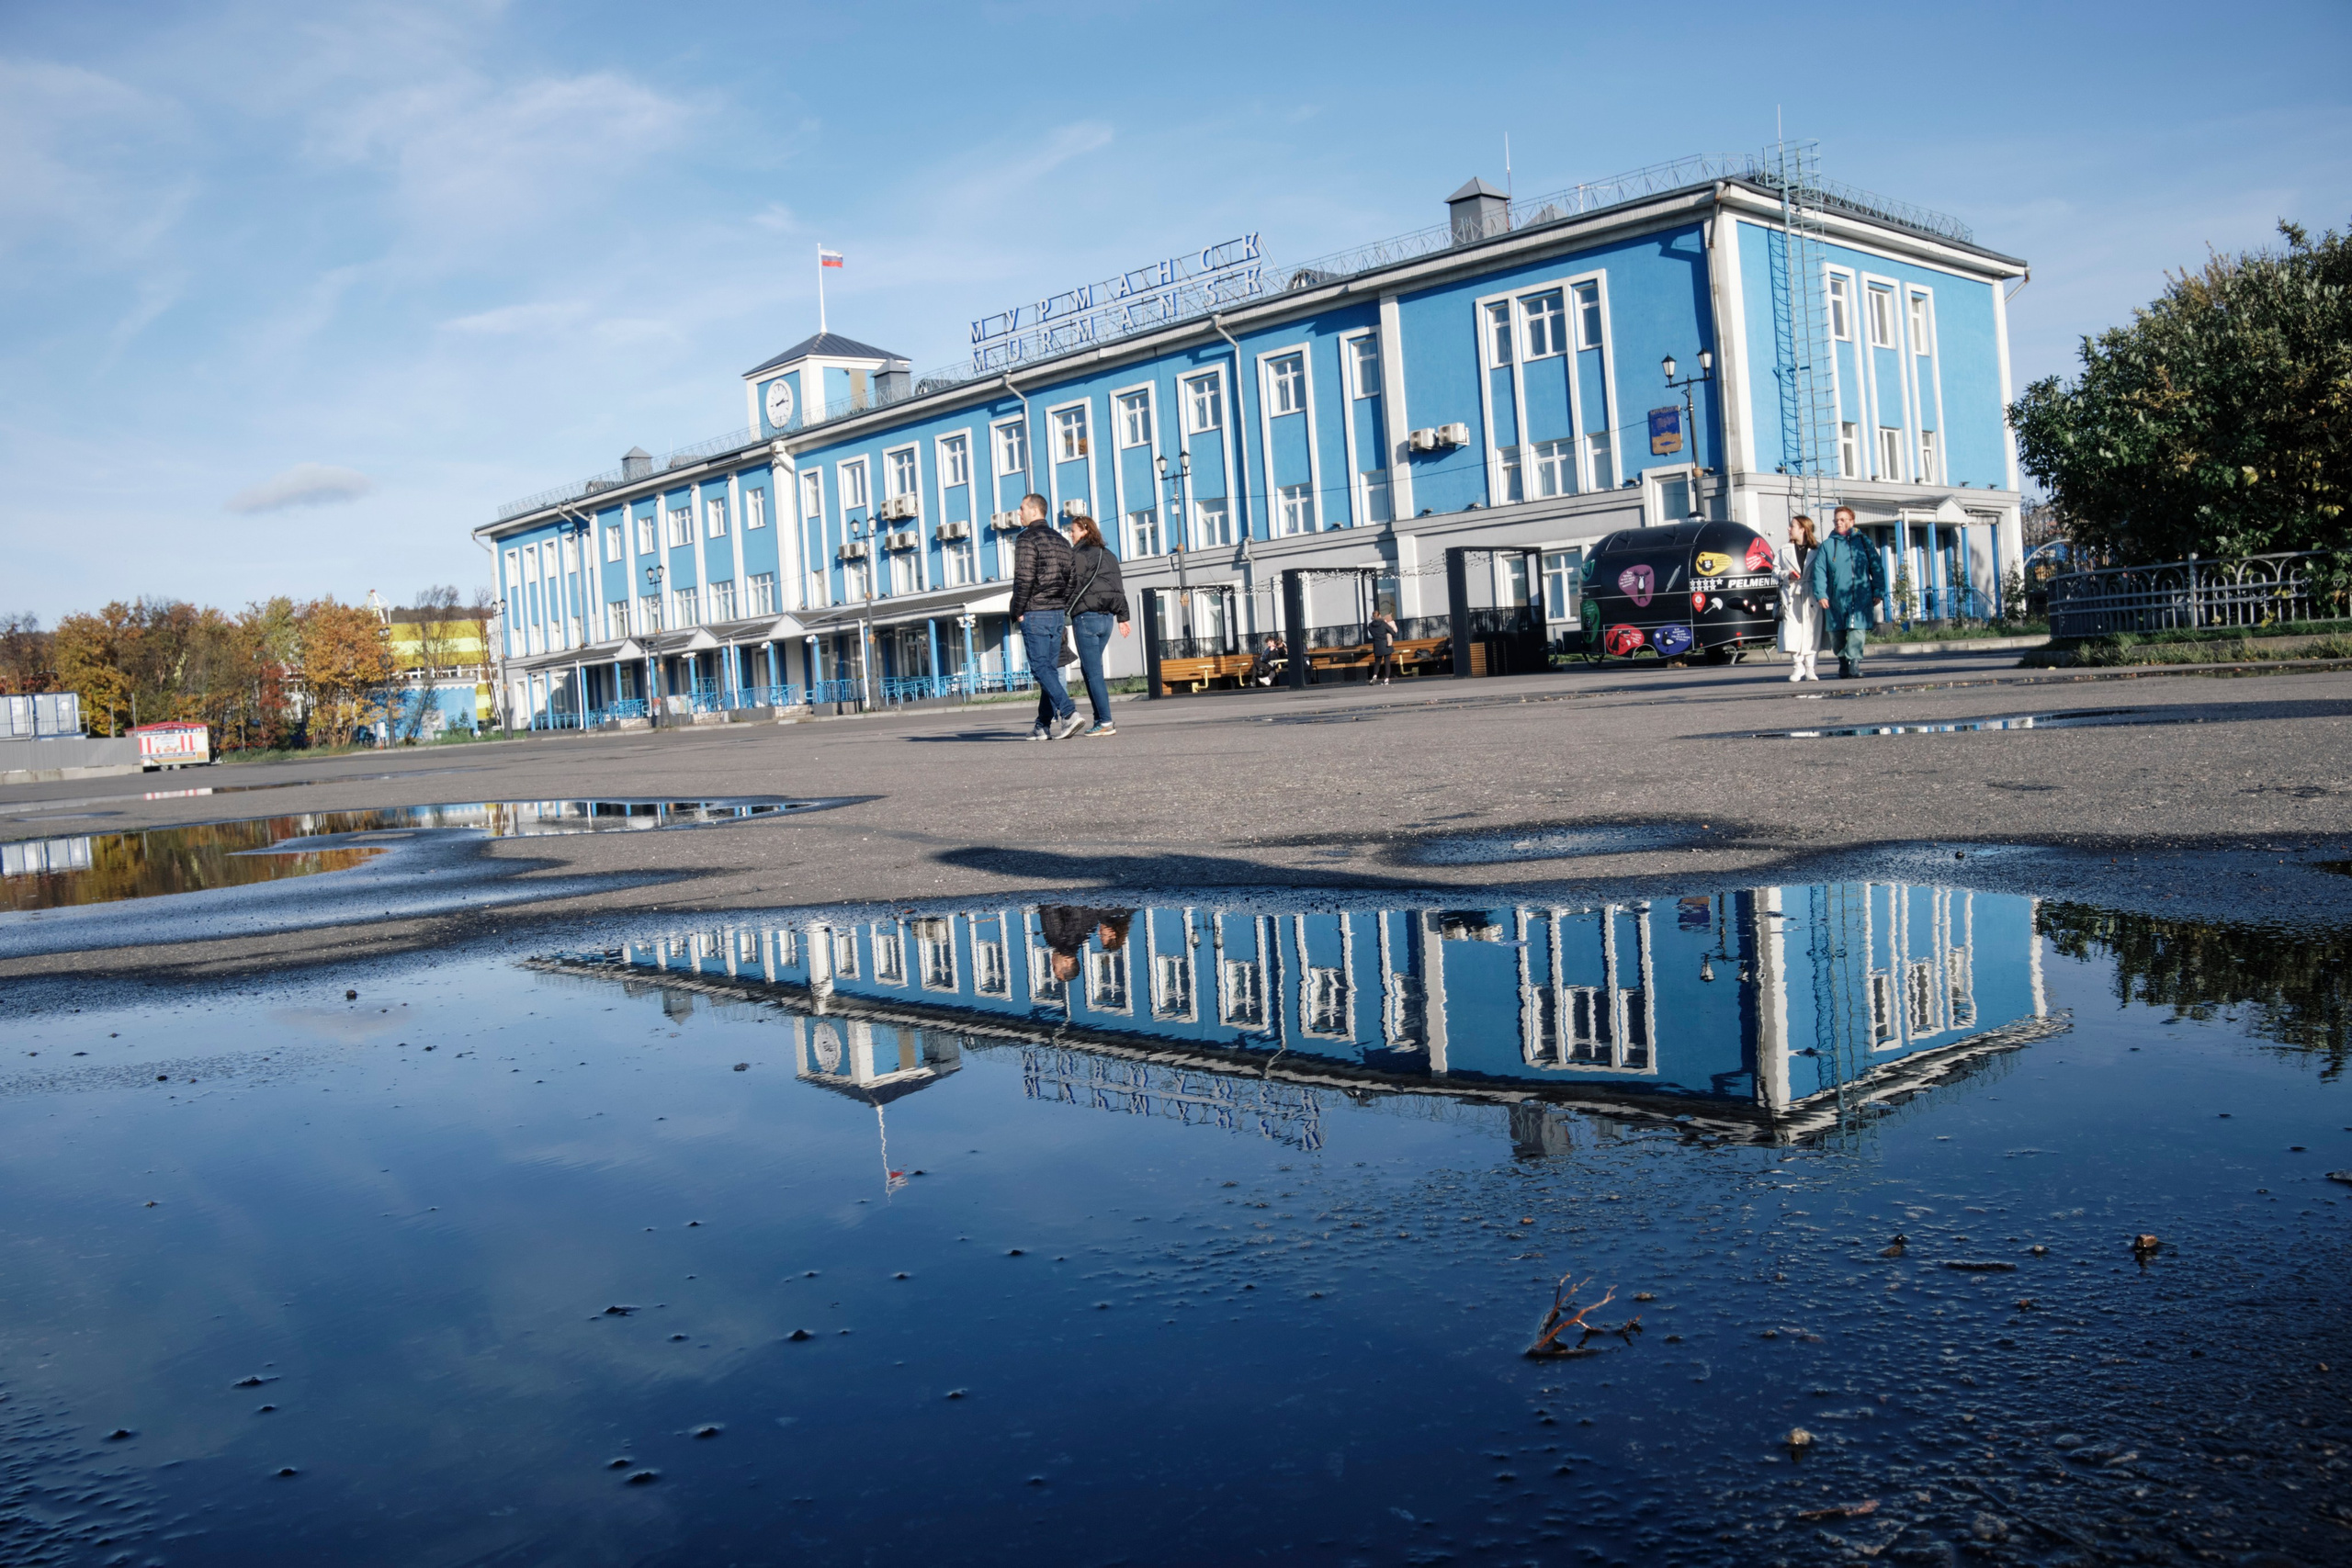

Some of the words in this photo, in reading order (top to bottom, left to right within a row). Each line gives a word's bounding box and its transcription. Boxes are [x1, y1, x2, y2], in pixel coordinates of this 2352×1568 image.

[969, 231, 1260, 343] МУРМАНСК
[972, 266, 1262, 371] MURMANSK
[1727, 578, 1770, 589] PELMEN
